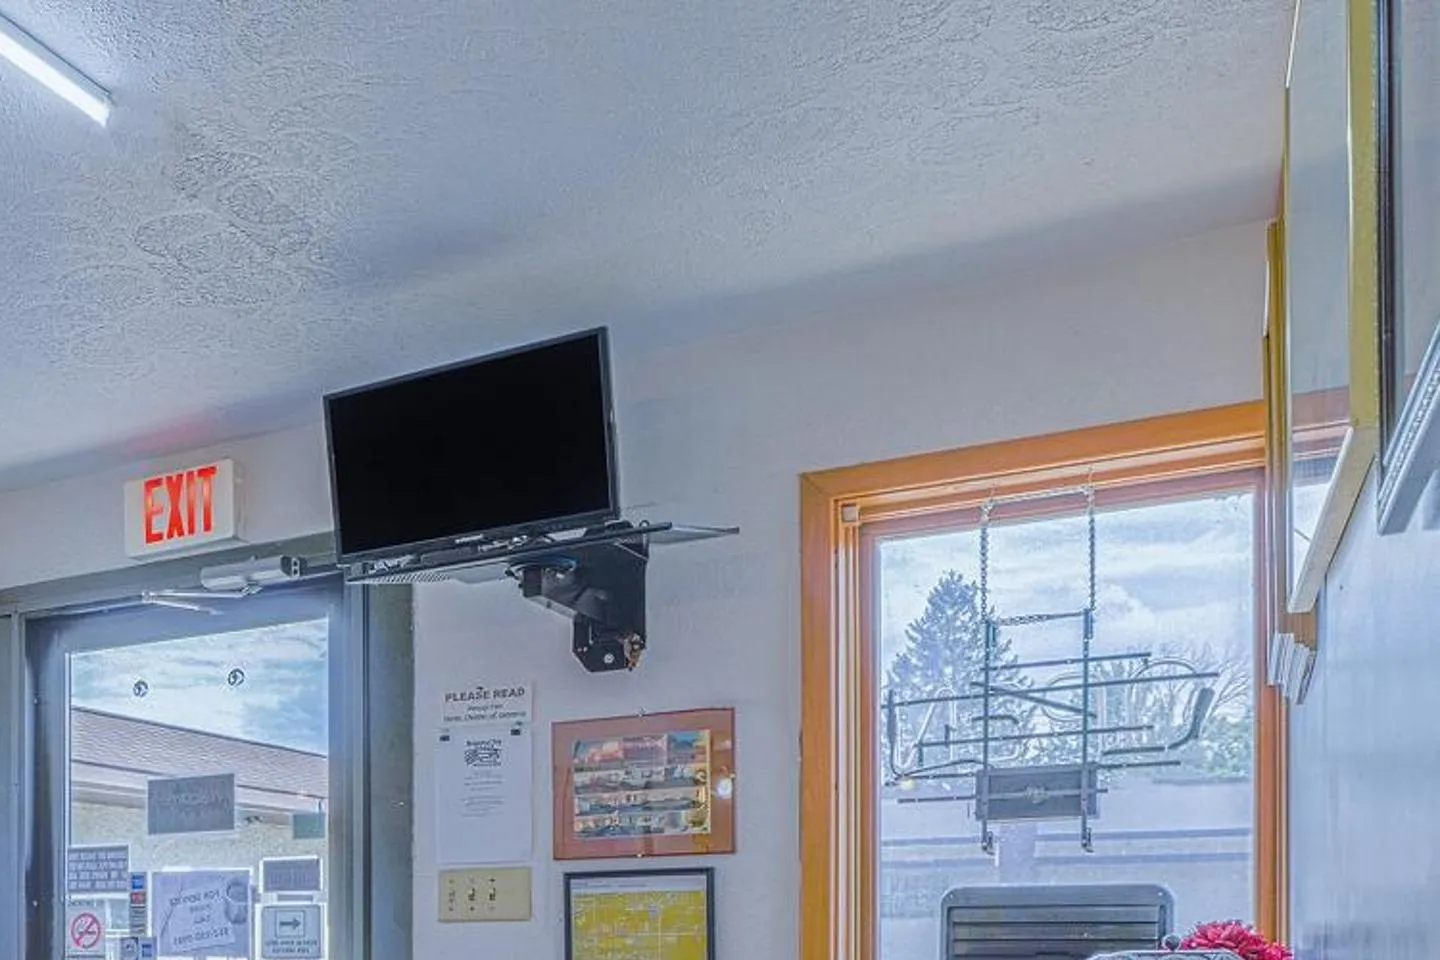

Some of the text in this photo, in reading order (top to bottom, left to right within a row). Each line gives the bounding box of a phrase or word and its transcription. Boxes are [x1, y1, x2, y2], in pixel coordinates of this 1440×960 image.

[144, 465, 217, 544] EXIT
[445, 687, 525, 702] PLEASE READ
